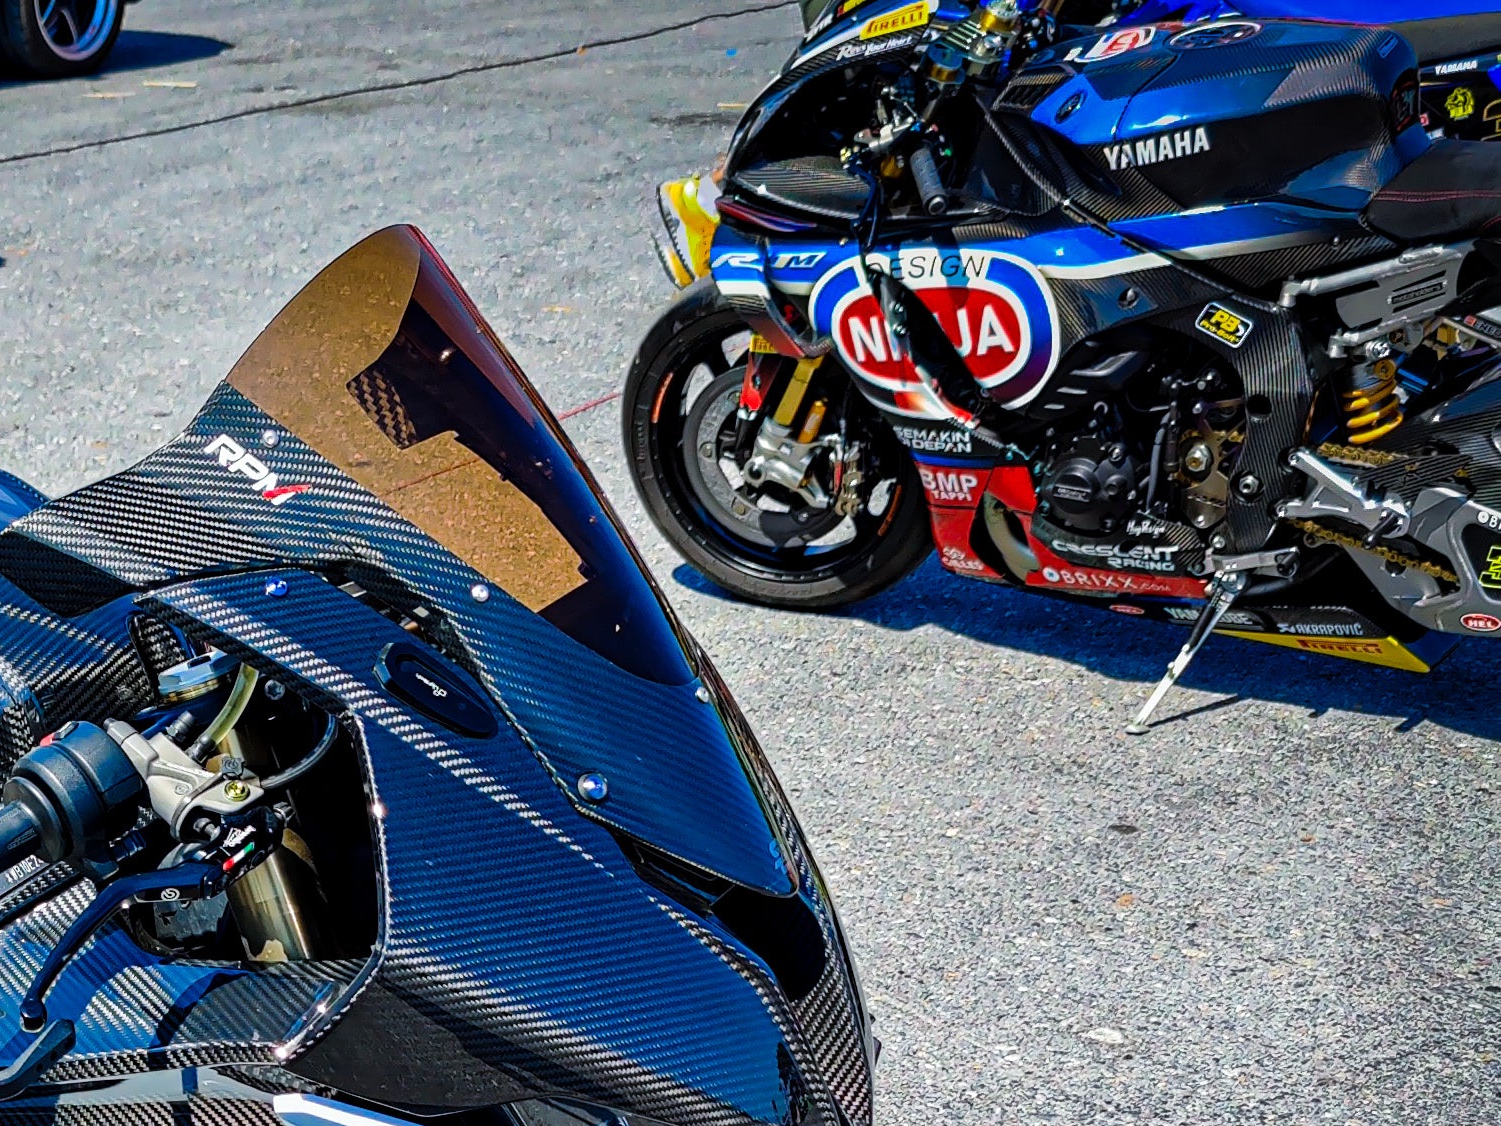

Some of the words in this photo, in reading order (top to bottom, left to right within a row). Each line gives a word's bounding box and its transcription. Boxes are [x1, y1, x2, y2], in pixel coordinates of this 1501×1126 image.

[867, 5, 925, 33] PIRELLI
[1102, 127, 1211, 171] YAMAHA
[868, 254, 986, 280] DESIGN
[848, 304, 1015, 363] NIJA
[203, 433, 311, 506] RPM
[919, 469, 978, 493] BMP
[1107, 557, 1176, 572] RACING
